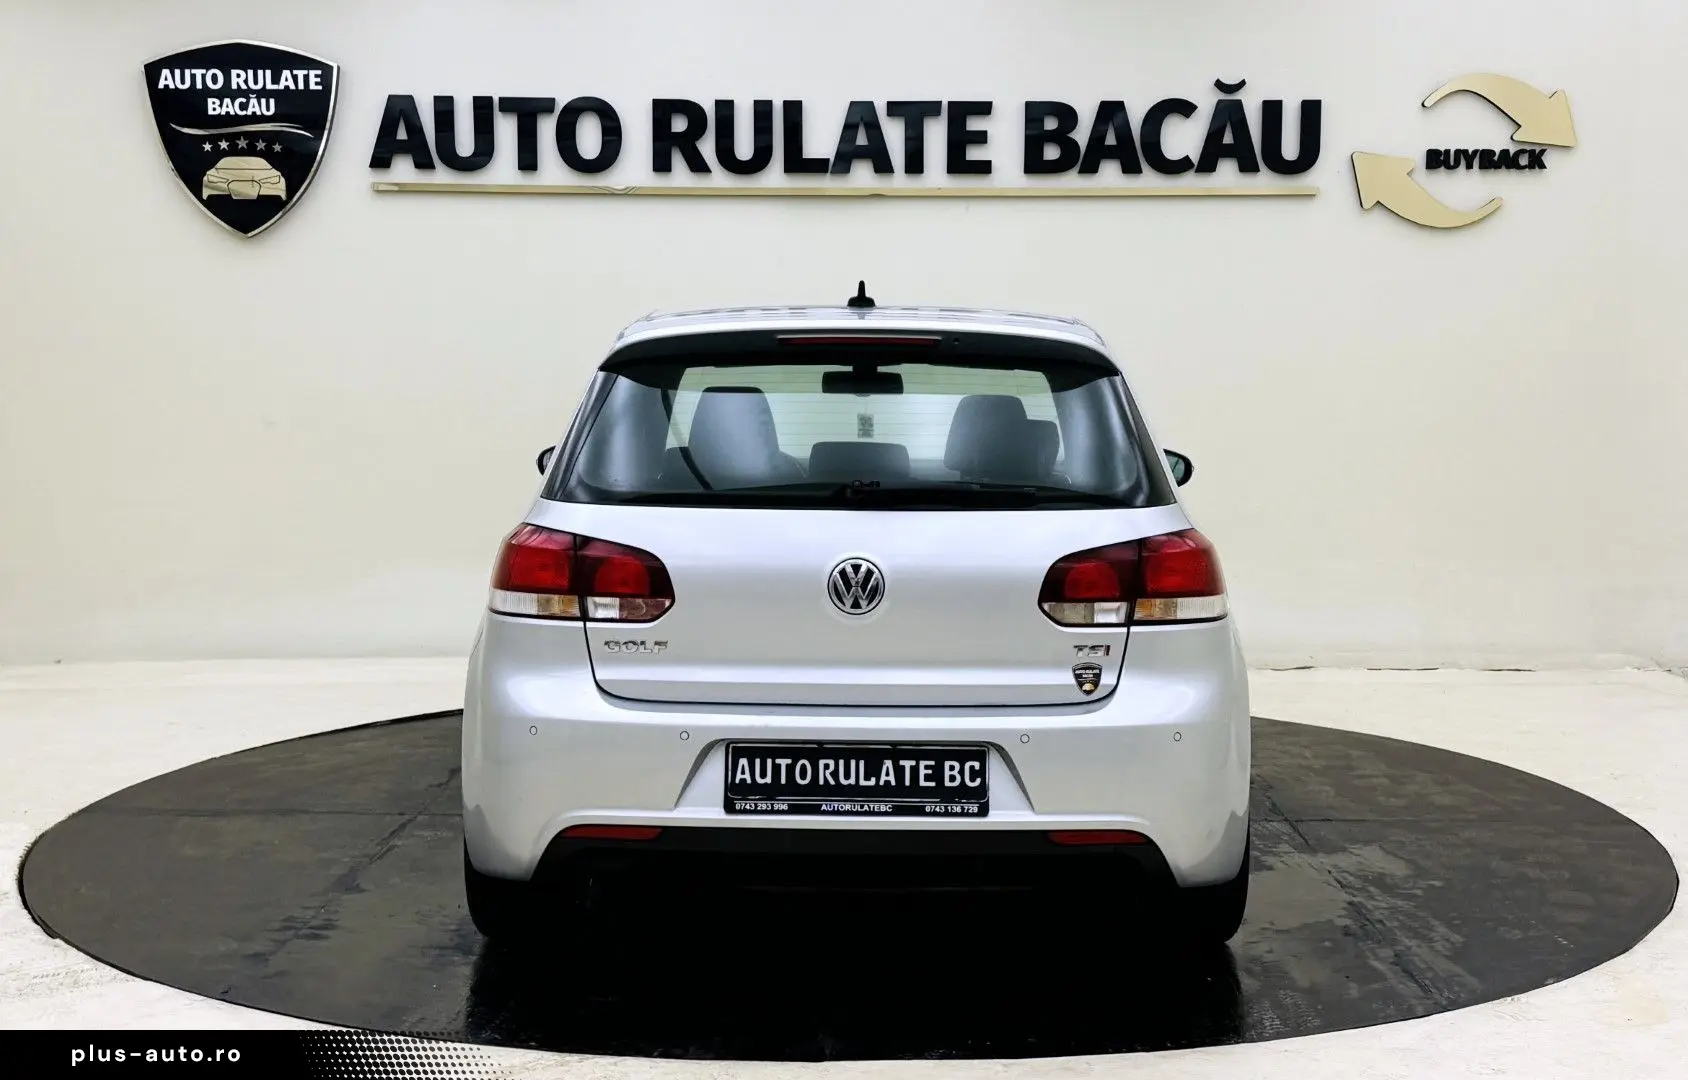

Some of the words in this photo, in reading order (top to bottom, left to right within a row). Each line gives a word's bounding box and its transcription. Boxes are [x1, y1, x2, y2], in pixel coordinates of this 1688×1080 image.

[158, 69, 224, 90] AUTO
[231, 69, 322, 90] RULATE
[207, 94, 276, 116] BACĂU
[369, 94, 622, 173] AUTO
[652, 98, 993, 175] RULATE
[1023, 78, 1322, 175] BACĂU
[1425, 148, 1548, 170] BUYBACK
[603, 640, 669, 654] GOLF
[1073, 644, 1111, 657] TSI
[735, 757, 812, 785] AUTO
[818, 759, 936, 787] RULATE
[943, 760, 982, 788] BC
[820, 803, 893, 812] AUTORULATEBC
[925, 805, 945, 813] 0743
[947, 805, 962, 813] 136
